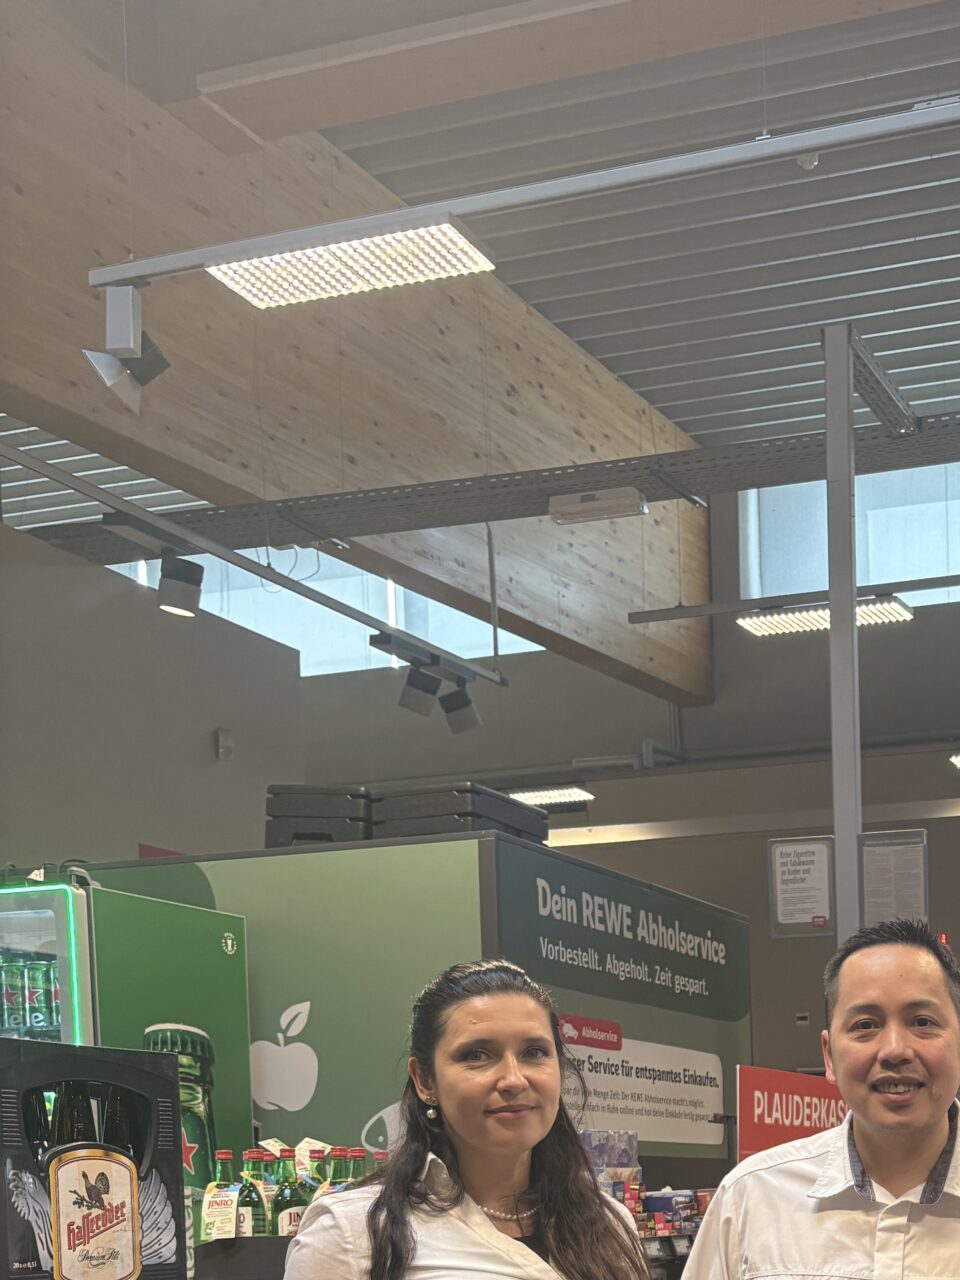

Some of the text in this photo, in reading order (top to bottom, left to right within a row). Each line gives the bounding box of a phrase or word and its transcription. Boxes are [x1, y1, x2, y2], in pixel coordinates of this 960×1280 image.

[536, 876, 727, 966] Dein REWE Abholservice
[539, 935, 709, 997] Vorbestellt. Abgeholt. Zeit gespart.
[582, 1025, 618, 1042] Abholservice
[588, 1054, 720, 1089] Service für entspanntes Einkaufen.
[208, 1198, 234, 1210] JINRO
